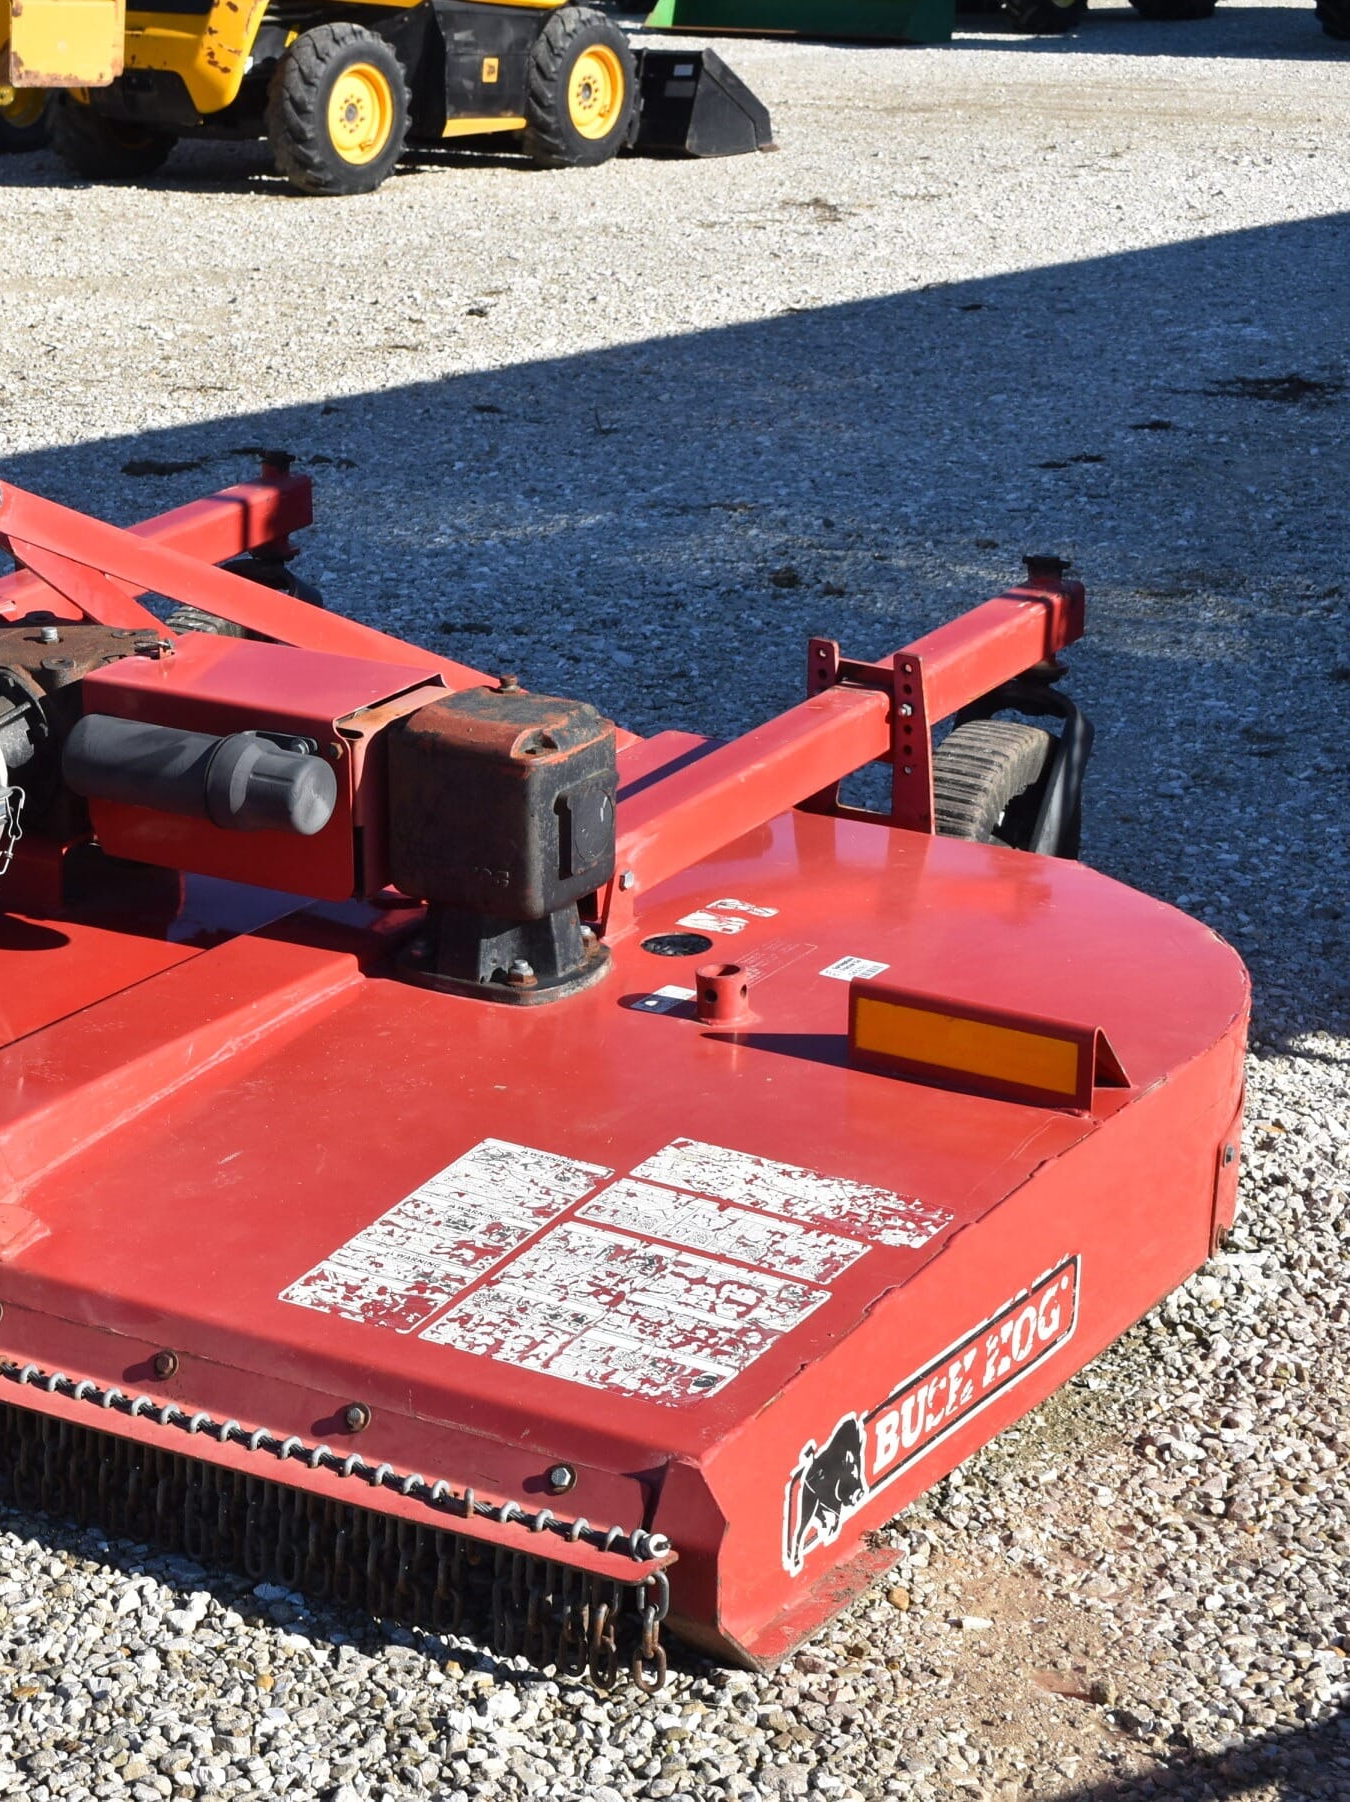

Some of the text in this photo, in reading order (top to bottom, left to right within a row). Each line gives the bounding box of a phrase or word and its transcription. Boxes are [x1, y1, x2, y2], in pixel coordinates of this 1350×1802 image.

[530, 1151, 574, 1167] WARNING
[456, 1205, 502, 1221] WARNING
[395, 1253, 442, 1269] WARNING
